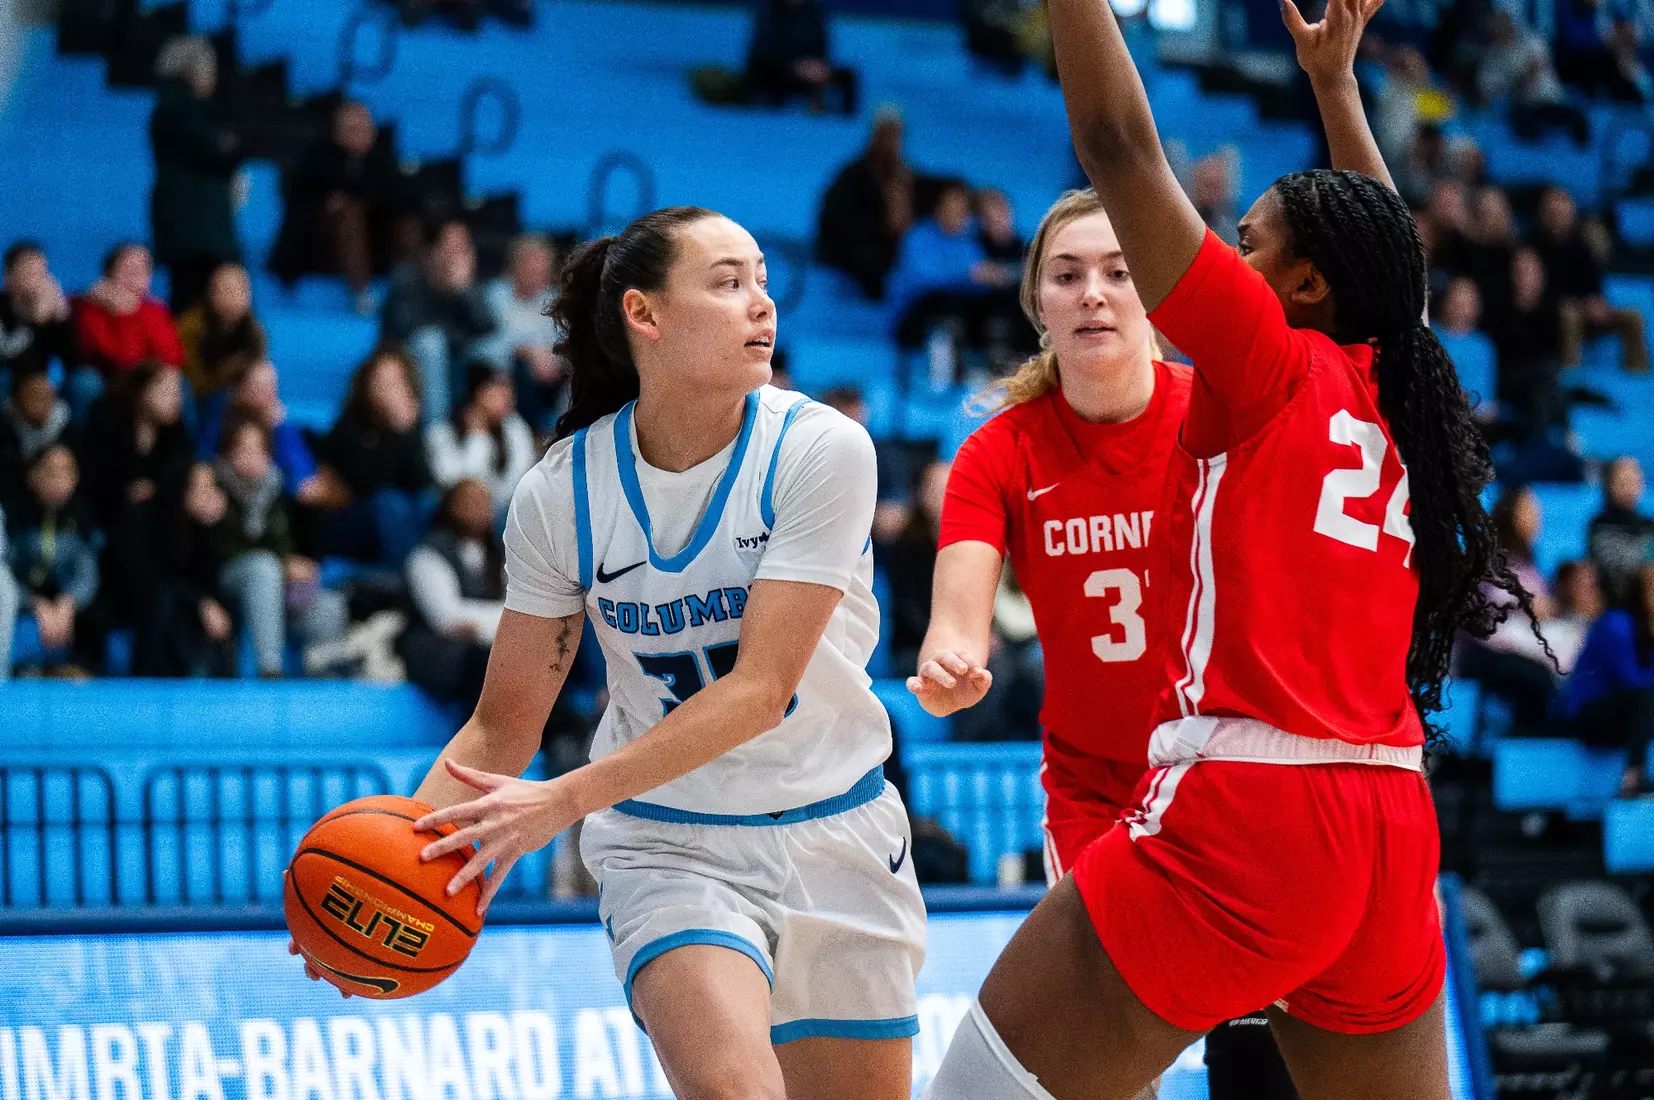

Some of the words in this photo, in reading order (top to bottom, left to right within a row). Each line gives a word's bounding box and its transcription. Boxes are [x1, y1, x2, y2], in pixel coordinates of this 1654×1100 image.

[736, 536, 758, 549] Ivy
[598, 584, 753, 636] COLUMB
[1083, 568, 1150, 662] 3
[320, 880, 430, 958] ELITE
